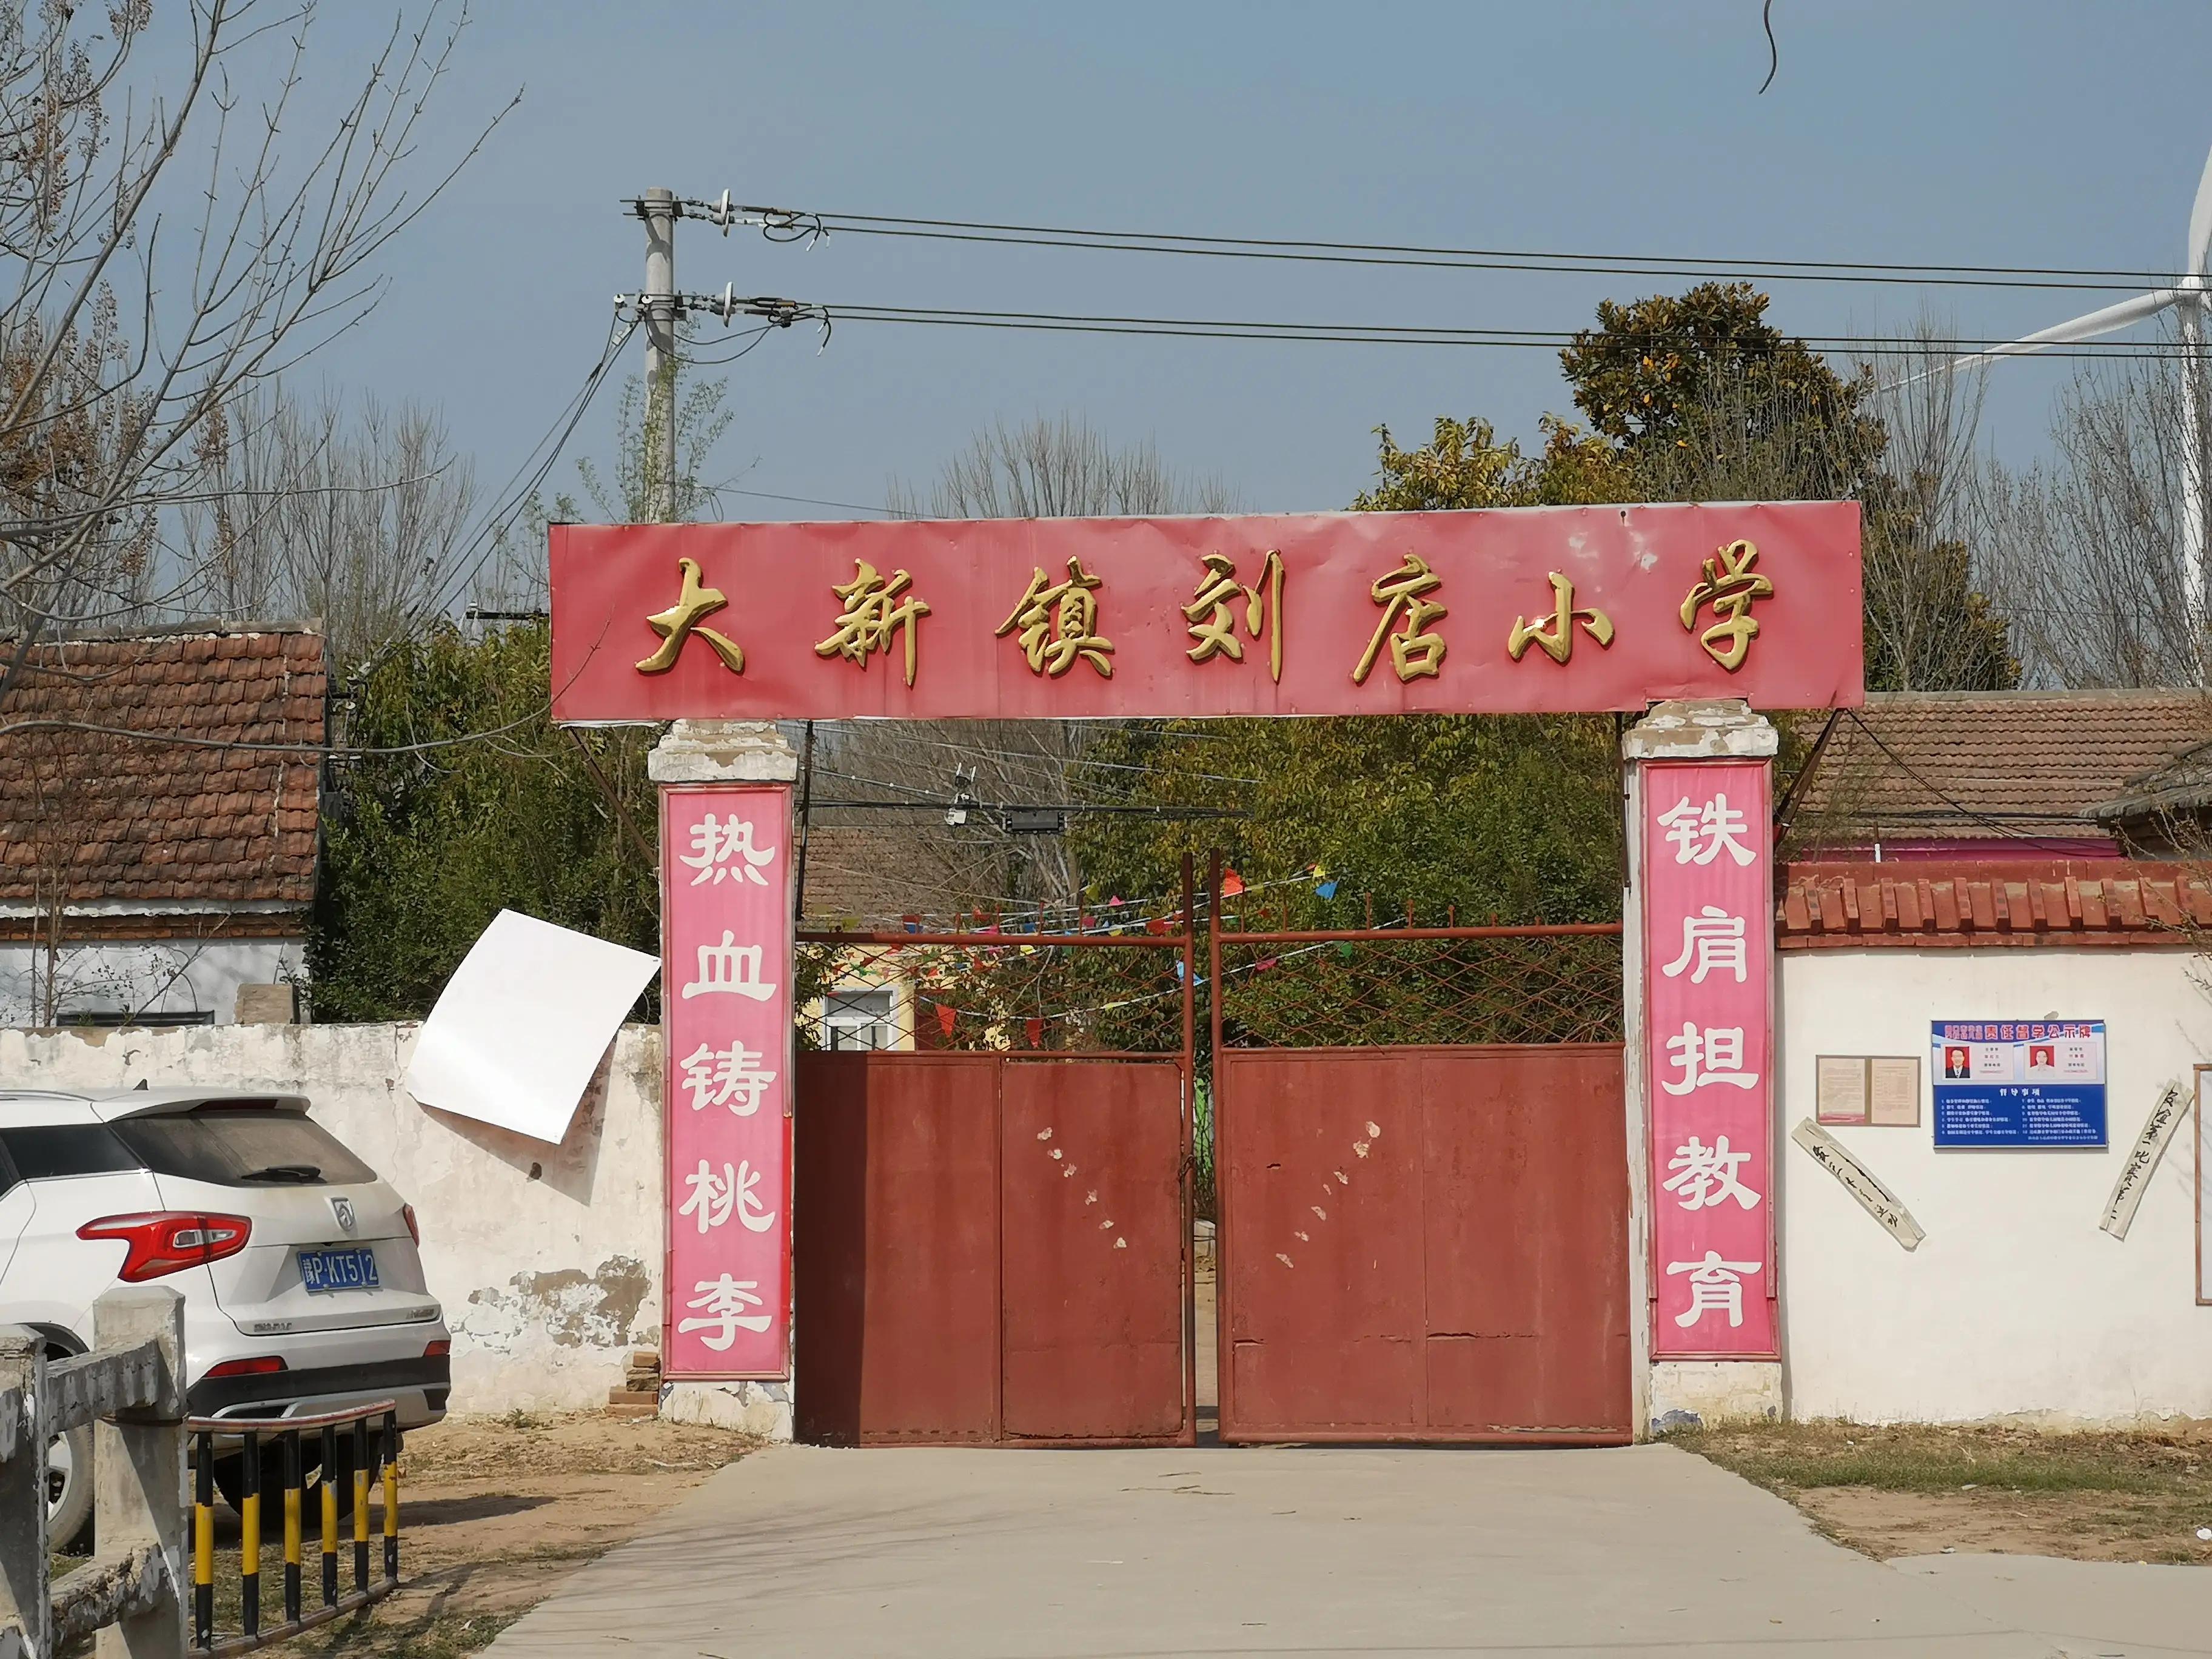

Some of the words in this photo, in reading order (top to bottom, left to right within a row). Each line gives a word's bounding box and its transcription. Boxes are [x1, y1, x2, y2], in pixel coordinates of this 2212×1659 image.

[634, 539, 1774, 685] 大新镇刘店小学
[677, 813, 777, 1352] 热血铸桃李
[1656, 793, 1763, 1328] 铁肩担教育
[1985, 1024, 2091, 1040] 责任督学公示牌
